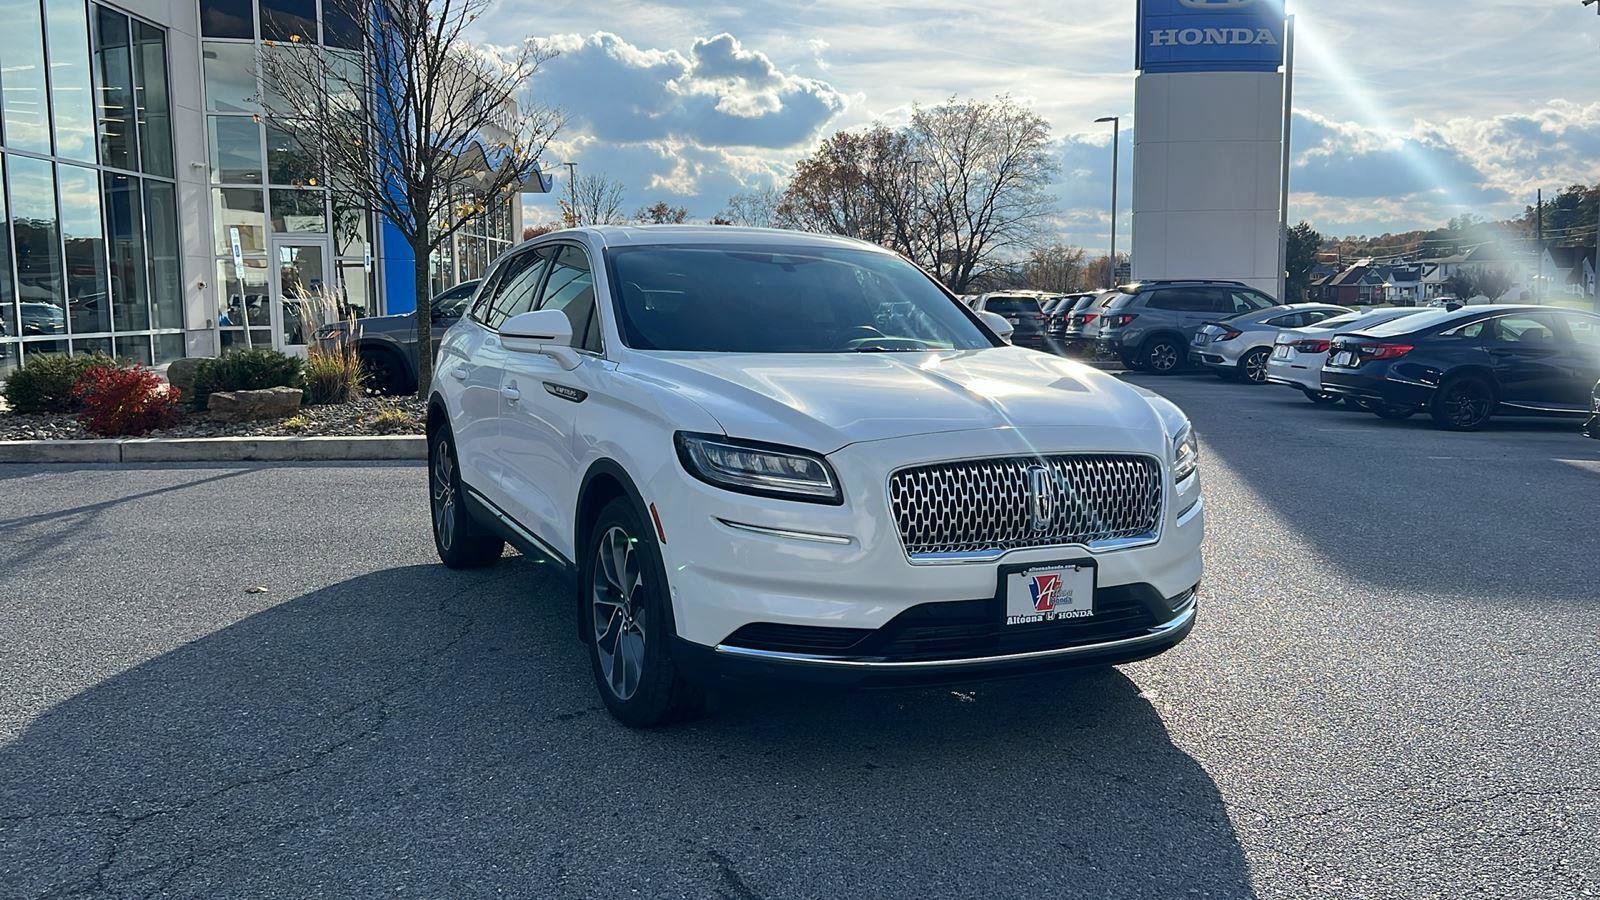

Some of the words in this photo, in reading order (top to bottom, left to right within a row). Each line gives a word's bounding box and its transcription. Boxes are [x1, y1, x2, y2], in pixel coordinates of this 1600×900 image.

[1149, 28, 1278, 46] HONDA
[1007, 615, 1043, 625] Altoona
[1058, 609, 1094, 620] HONDA
